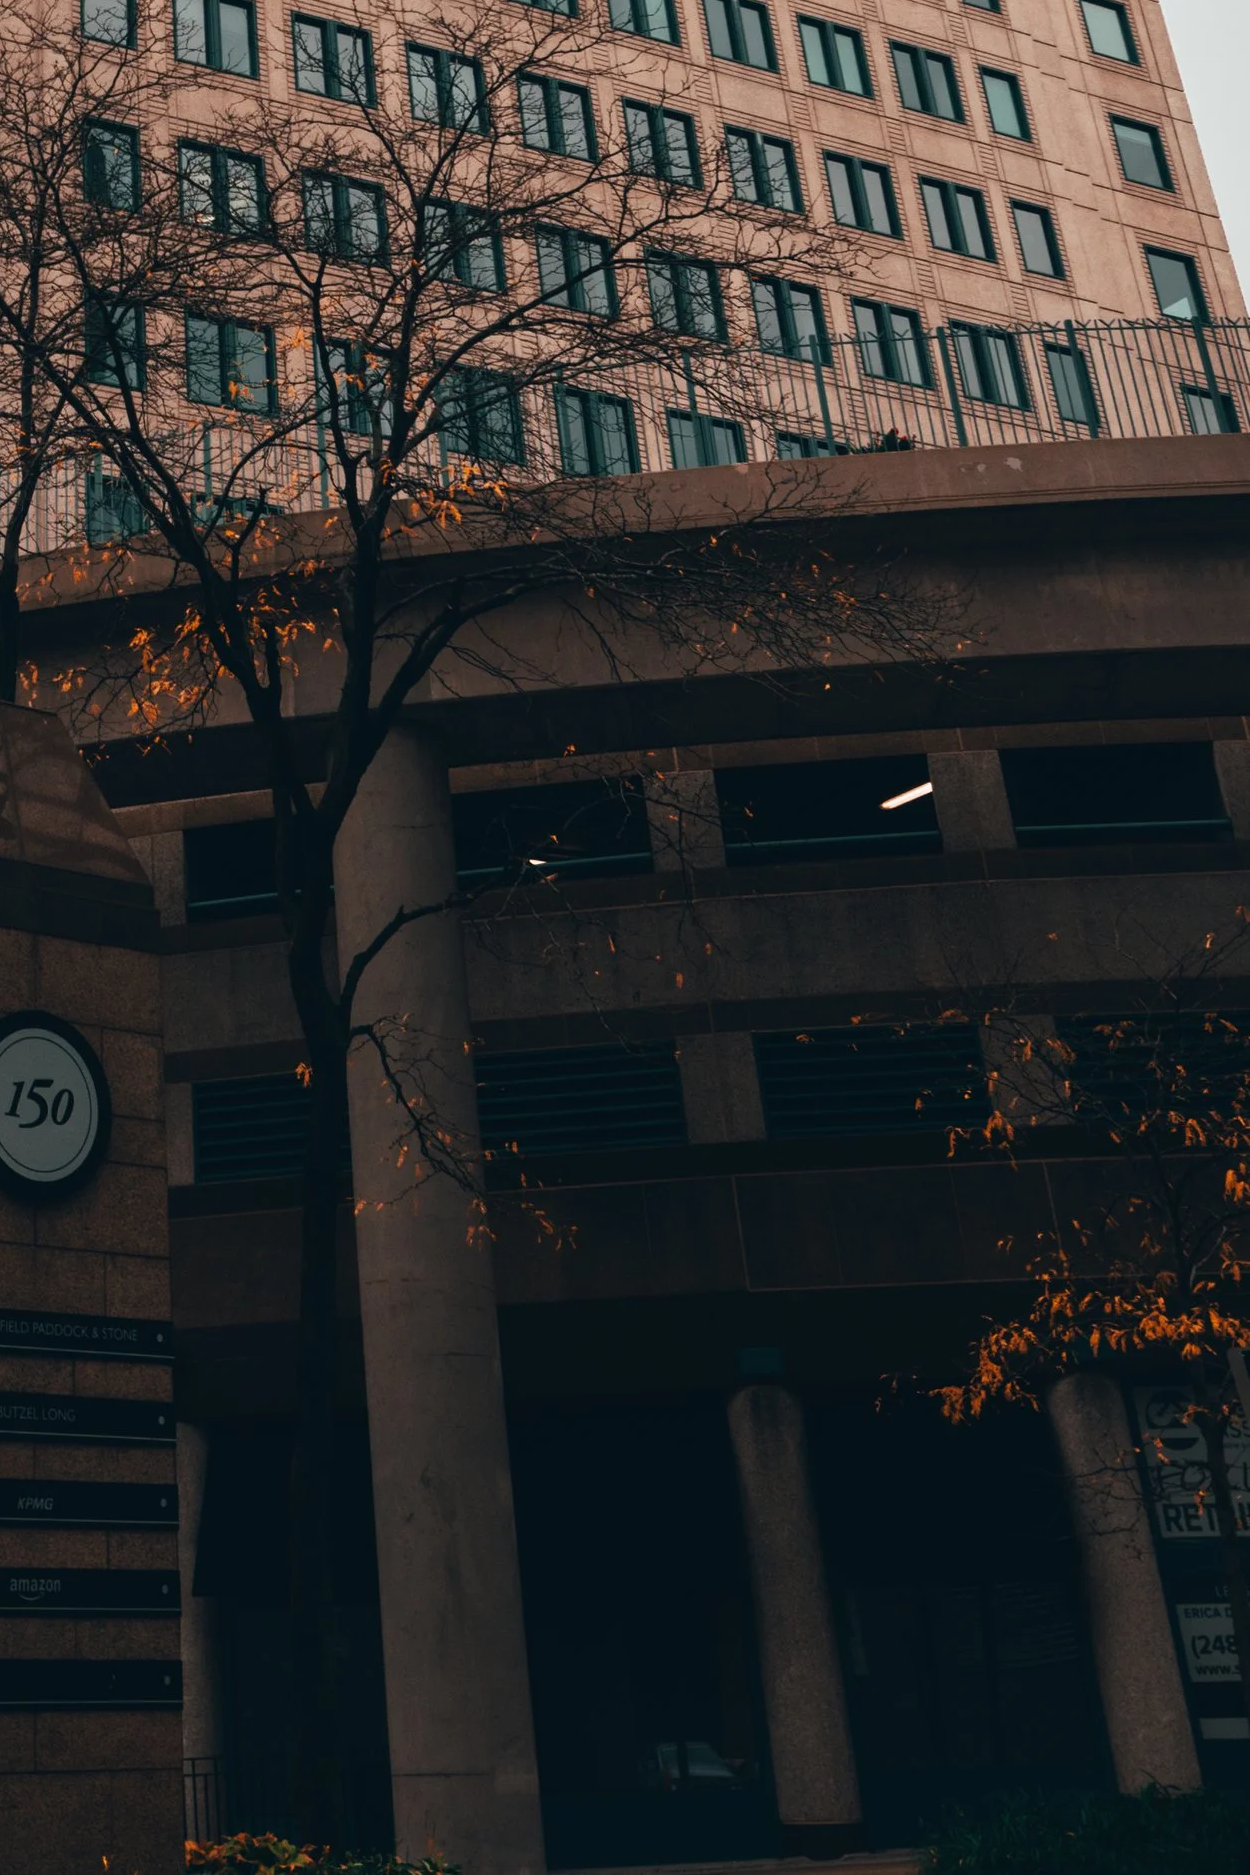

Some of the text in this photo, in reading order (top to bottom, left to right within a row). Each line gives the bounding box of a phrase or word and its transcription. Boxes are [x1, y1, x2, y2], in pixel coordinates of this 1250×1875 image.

[4, 1078, 75, 1129] 150
[32, 1323, 89, 1339] PADDOCK
[91, 1327, 100, 1339] &
[101, 1327, 138, 1342] STONE
[42, 1406, 76, 1422] LONG
[17, 1497, 54, 1511] KPMG
[10, 1577, 61, 1594] amazon
[1184, 1607, 1221, 1619] ERICA
